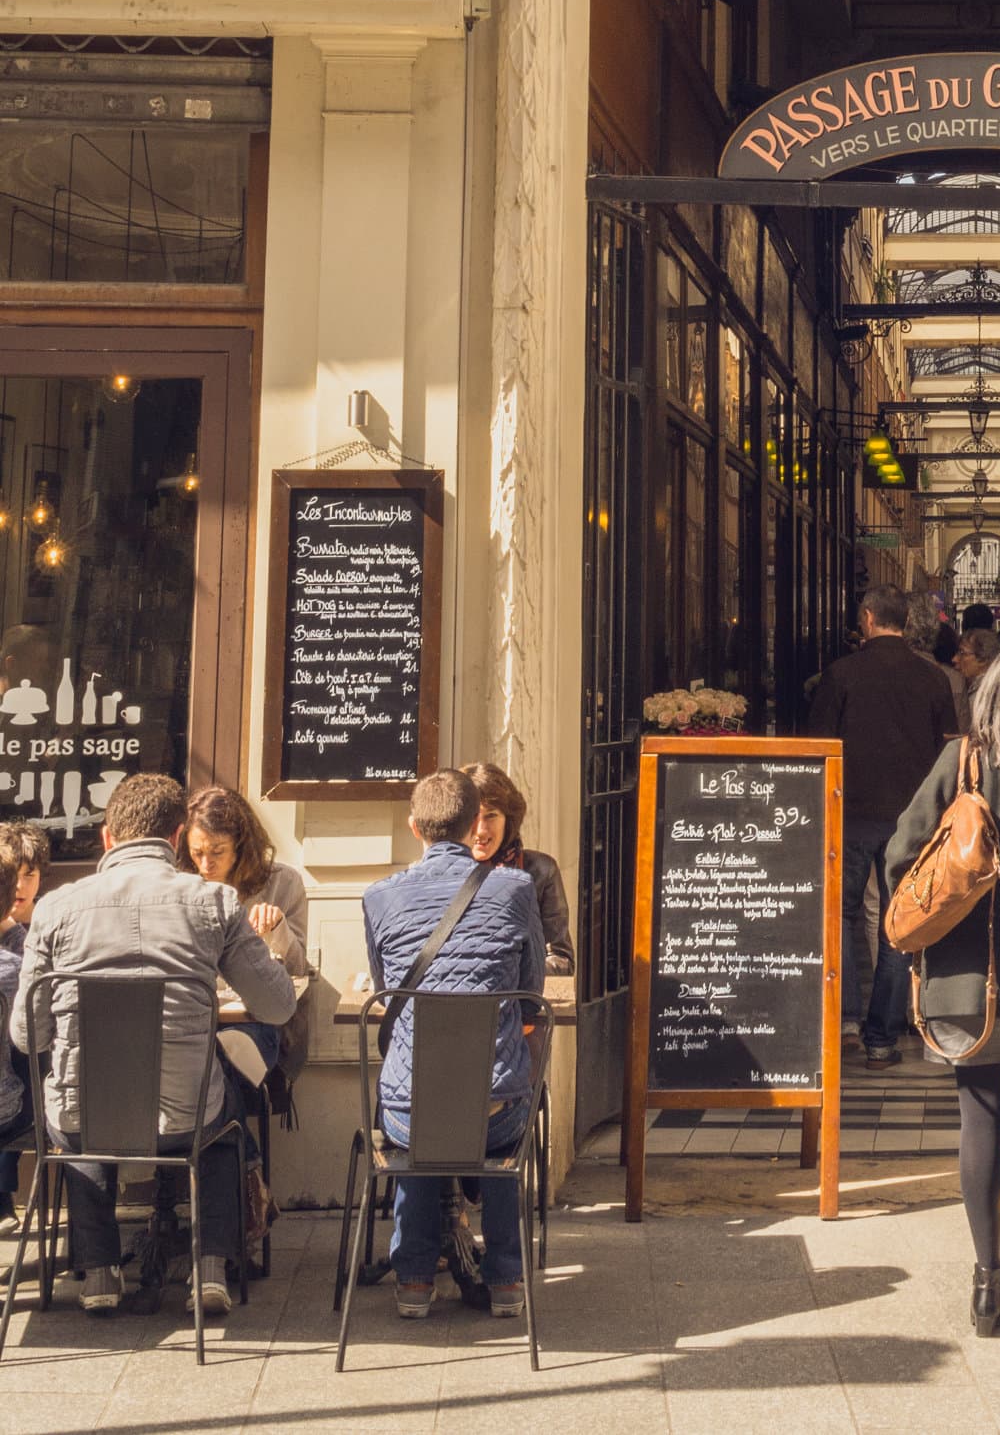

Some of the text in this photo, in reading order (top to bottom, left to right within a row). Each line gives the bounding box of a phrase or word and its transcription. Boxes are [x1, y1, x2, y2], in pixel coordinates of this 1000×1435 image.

[739, 65, 921, 174] PASSAGE
[925, 77, 974, 111] DU
[809, 133, 870, 169] VERS
[873, 125, 902, 149] LE
[296, 495, 322, 522] Les
[0, 732, 140, 763] le pas sage
[700, 772, 720, 794] Le
[721, 769, 745, 795] Pas
